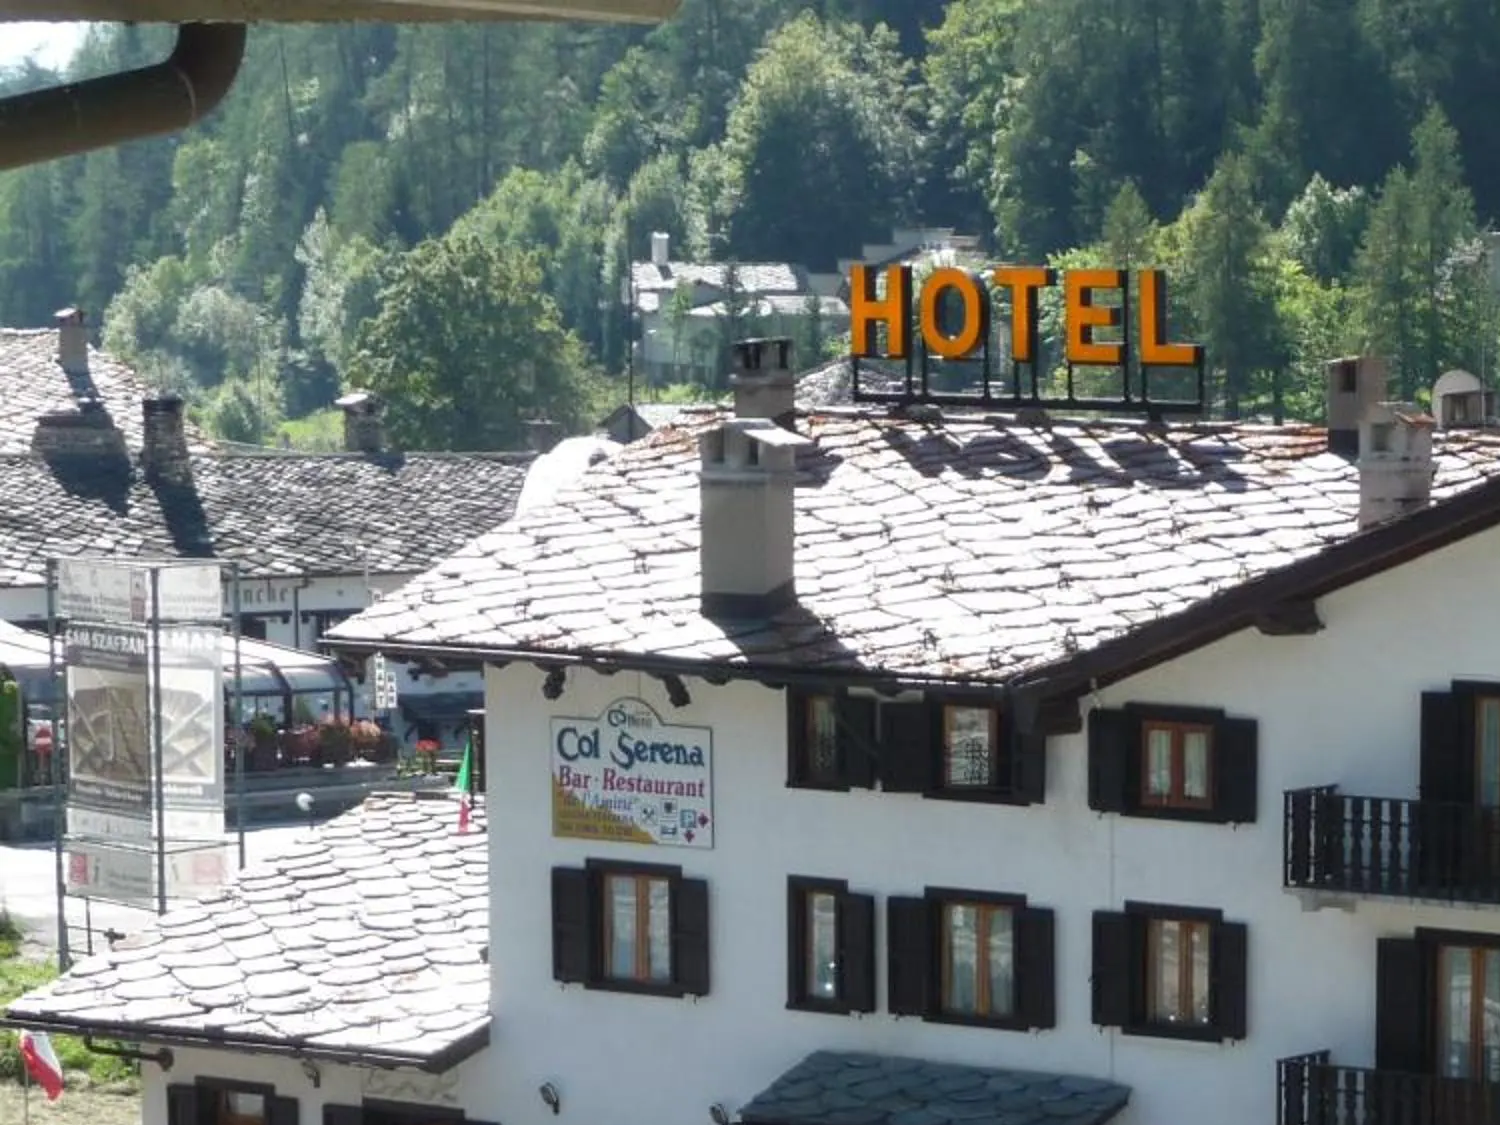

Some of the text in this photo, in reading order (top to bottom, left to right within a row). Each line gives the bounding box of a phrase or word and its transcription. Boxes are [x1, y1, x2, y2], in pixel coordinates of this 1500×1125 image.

[849, 263, 1203, 366] HOTEL
[556, 726, 705, 770] Col Serena
[558, 764, 706, 798] Bar Restaurant
